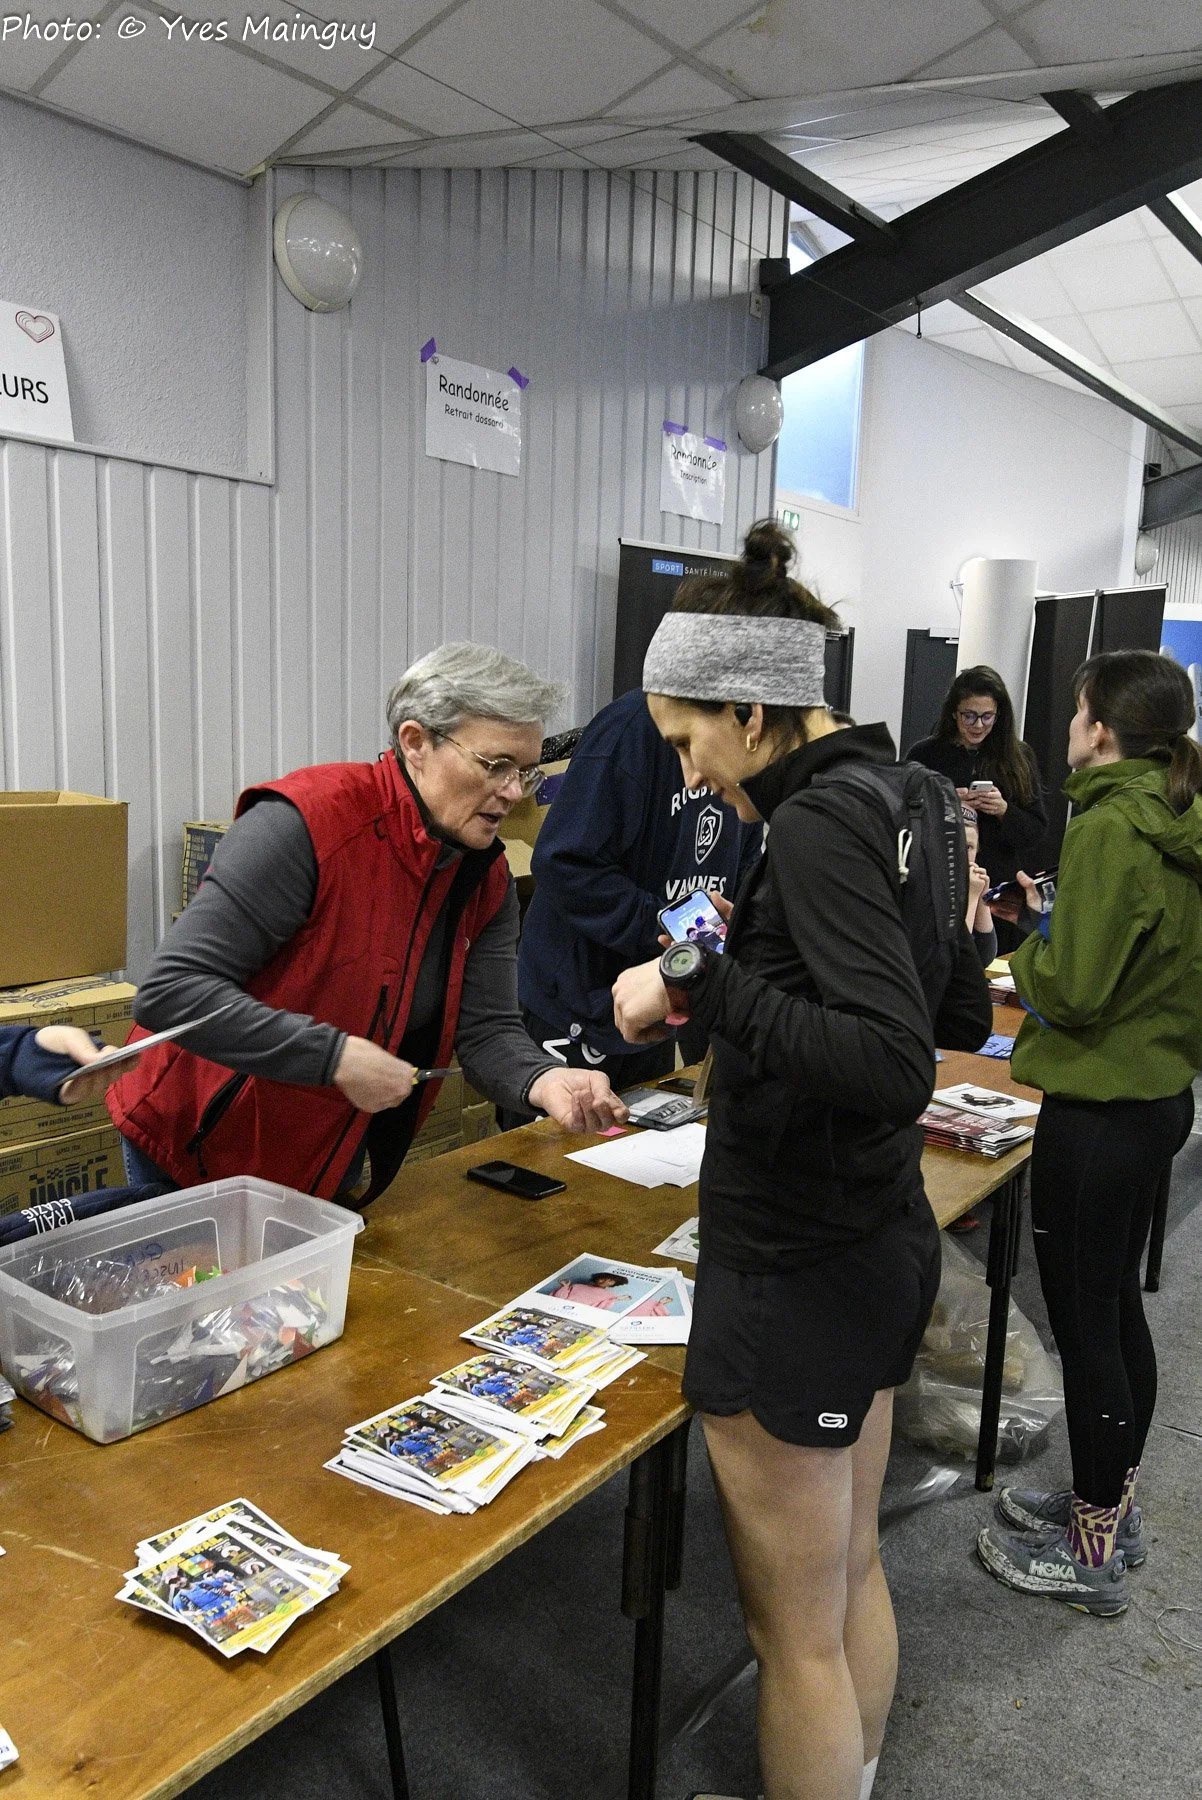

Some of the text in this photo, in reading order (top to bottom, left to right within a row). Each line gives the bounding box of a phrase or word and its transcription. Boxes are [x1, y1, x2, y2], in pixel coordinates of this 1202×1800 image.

[0, 372, 49, 404] URS
[438, 374, 510, 412] Randonnée
[444, 403, 473, 421] Retrait
[655, 562, 681, 574] SPORT
[670, 784, 714, 817] RUGB
[665, 875, 727, 901] VANNES
[20, 1197, 72, 1220] GLAZIG
[28, 1204, 77, 1236] TRAIL
[1028, 1559, 1077, 1582] HOKA
